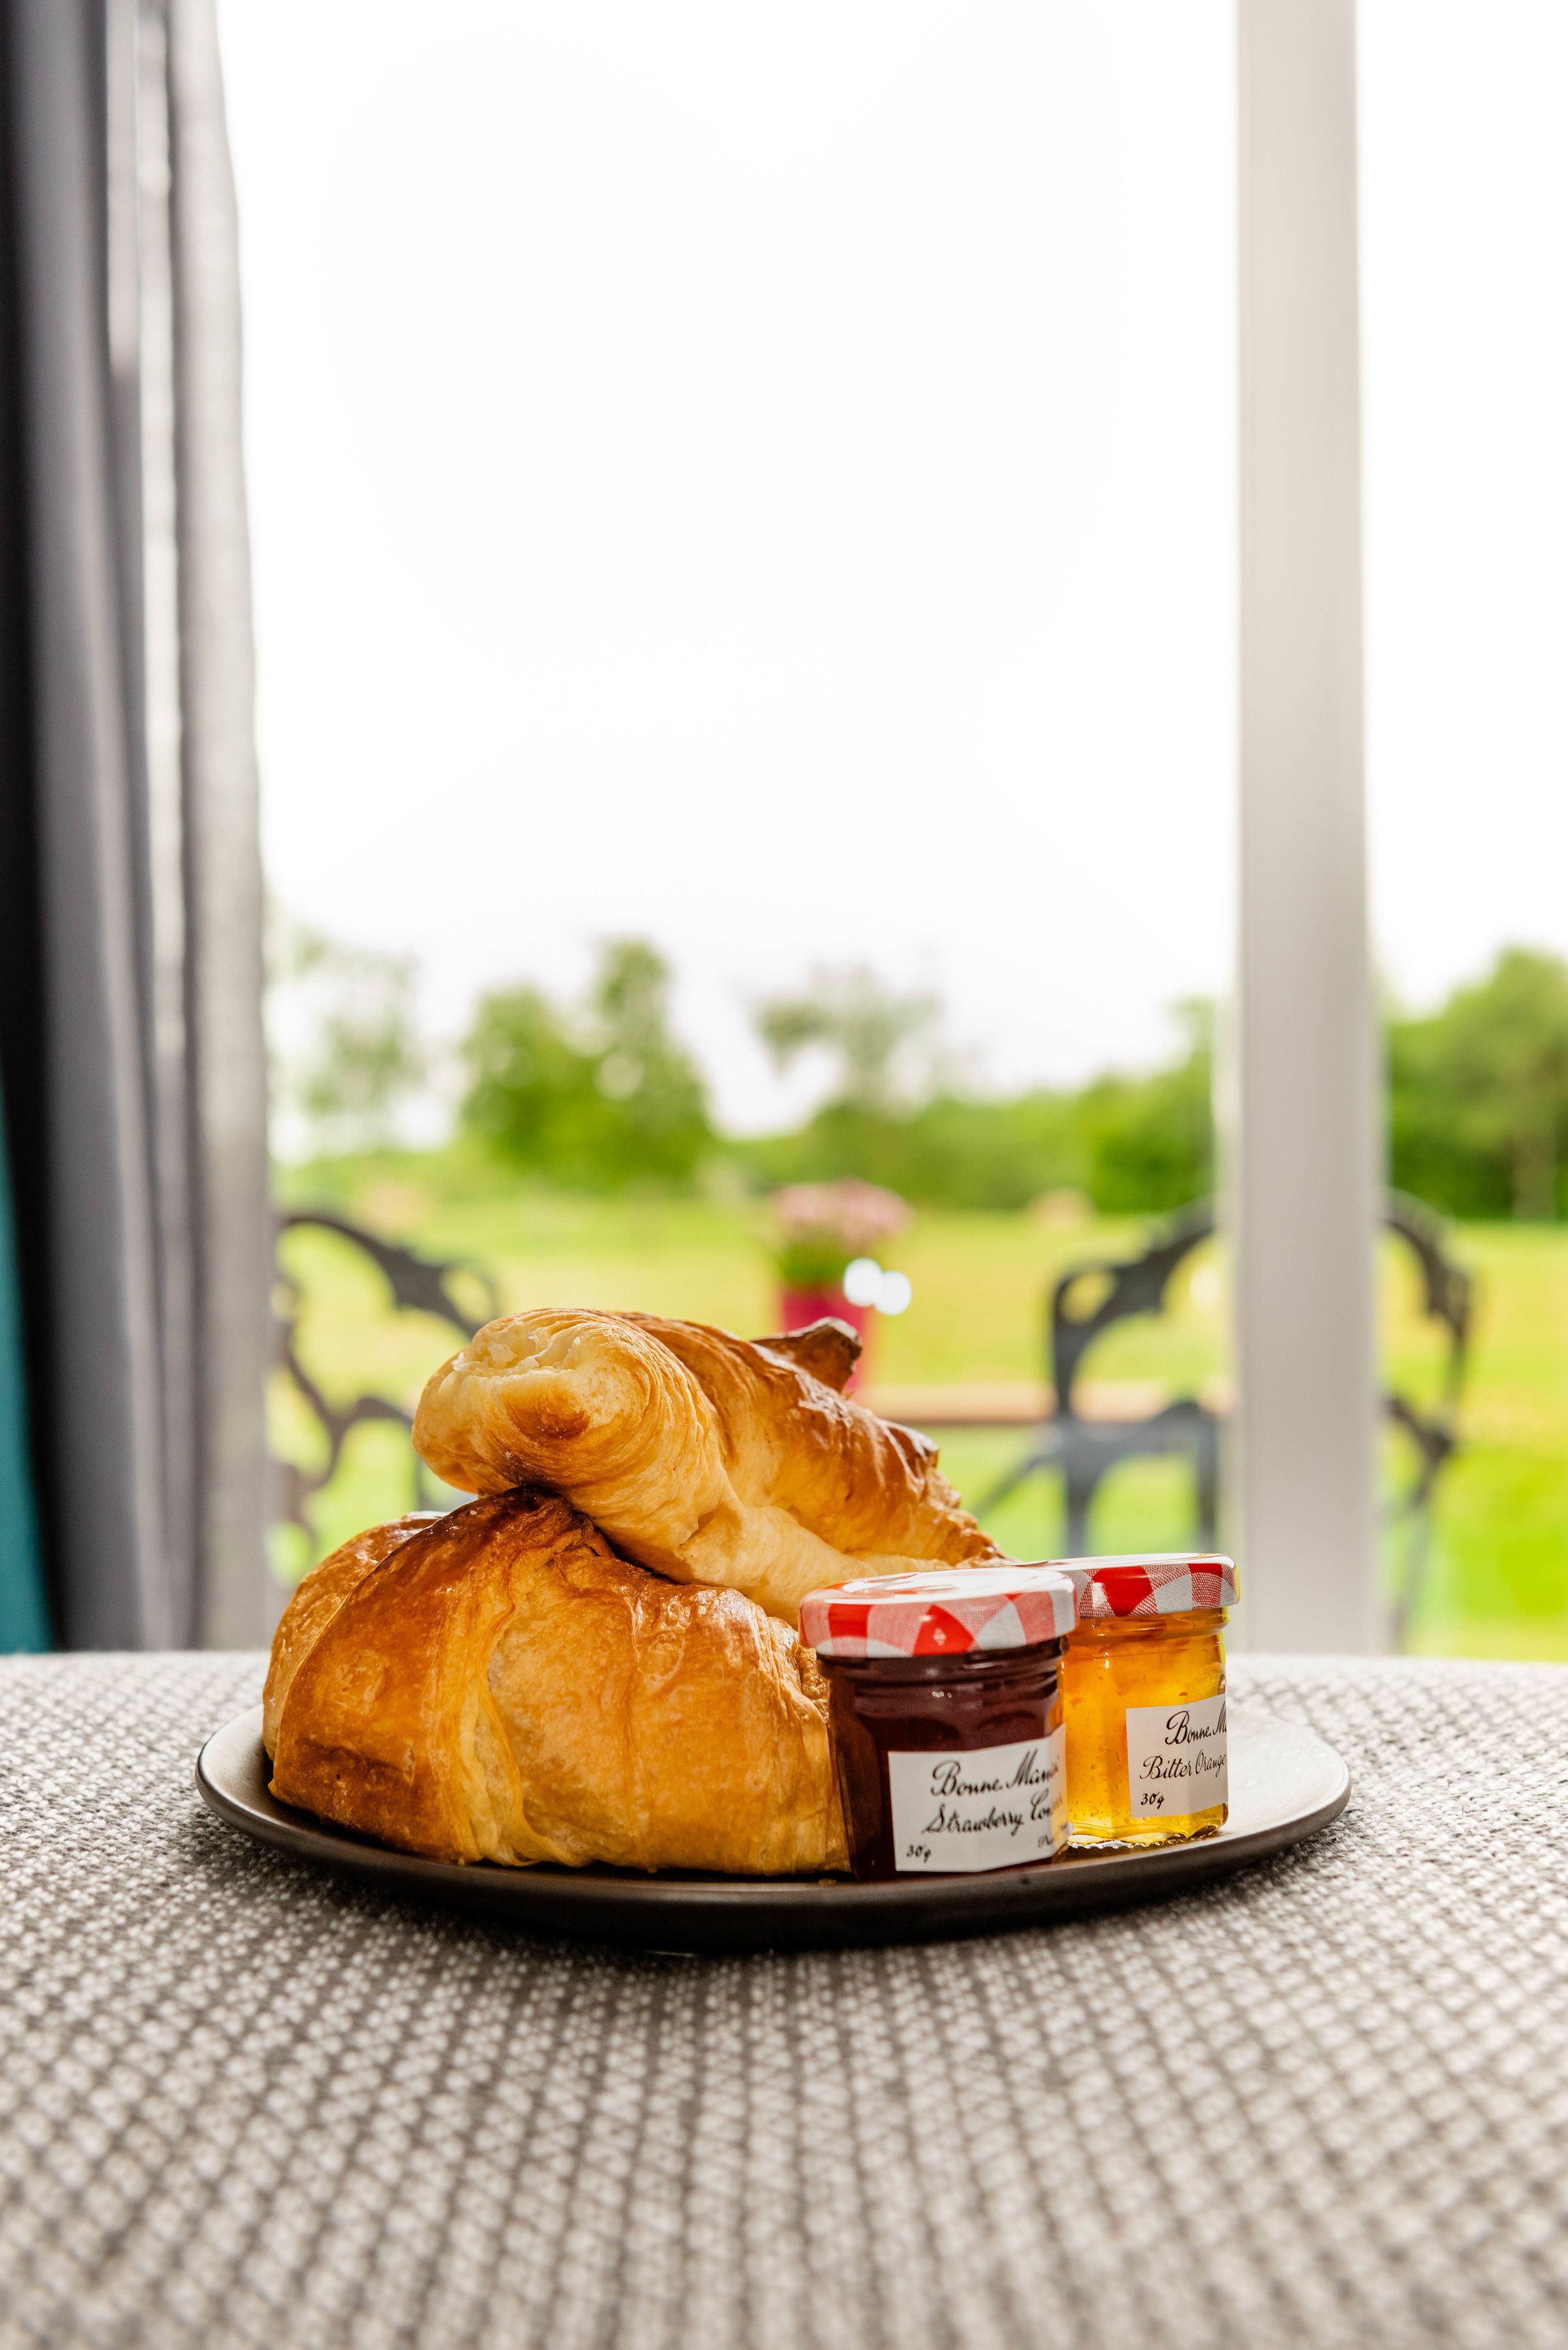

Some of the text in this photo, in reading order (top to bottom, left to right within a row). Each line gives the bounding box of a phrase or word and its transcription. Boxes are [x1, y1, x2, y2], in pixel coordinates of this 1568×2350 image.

[1165, 1700, 1227, 1745] Bonne M
[930, 1758, 1002, 1797] Bonne
[1139, 1749, 1226, 1780] Bitter Orange
[1141, 1791, 1165, 1810] 30g
[921, 1803, 1024, 1837] Strawberry
[906, 1844, 931, 1863] 30g
